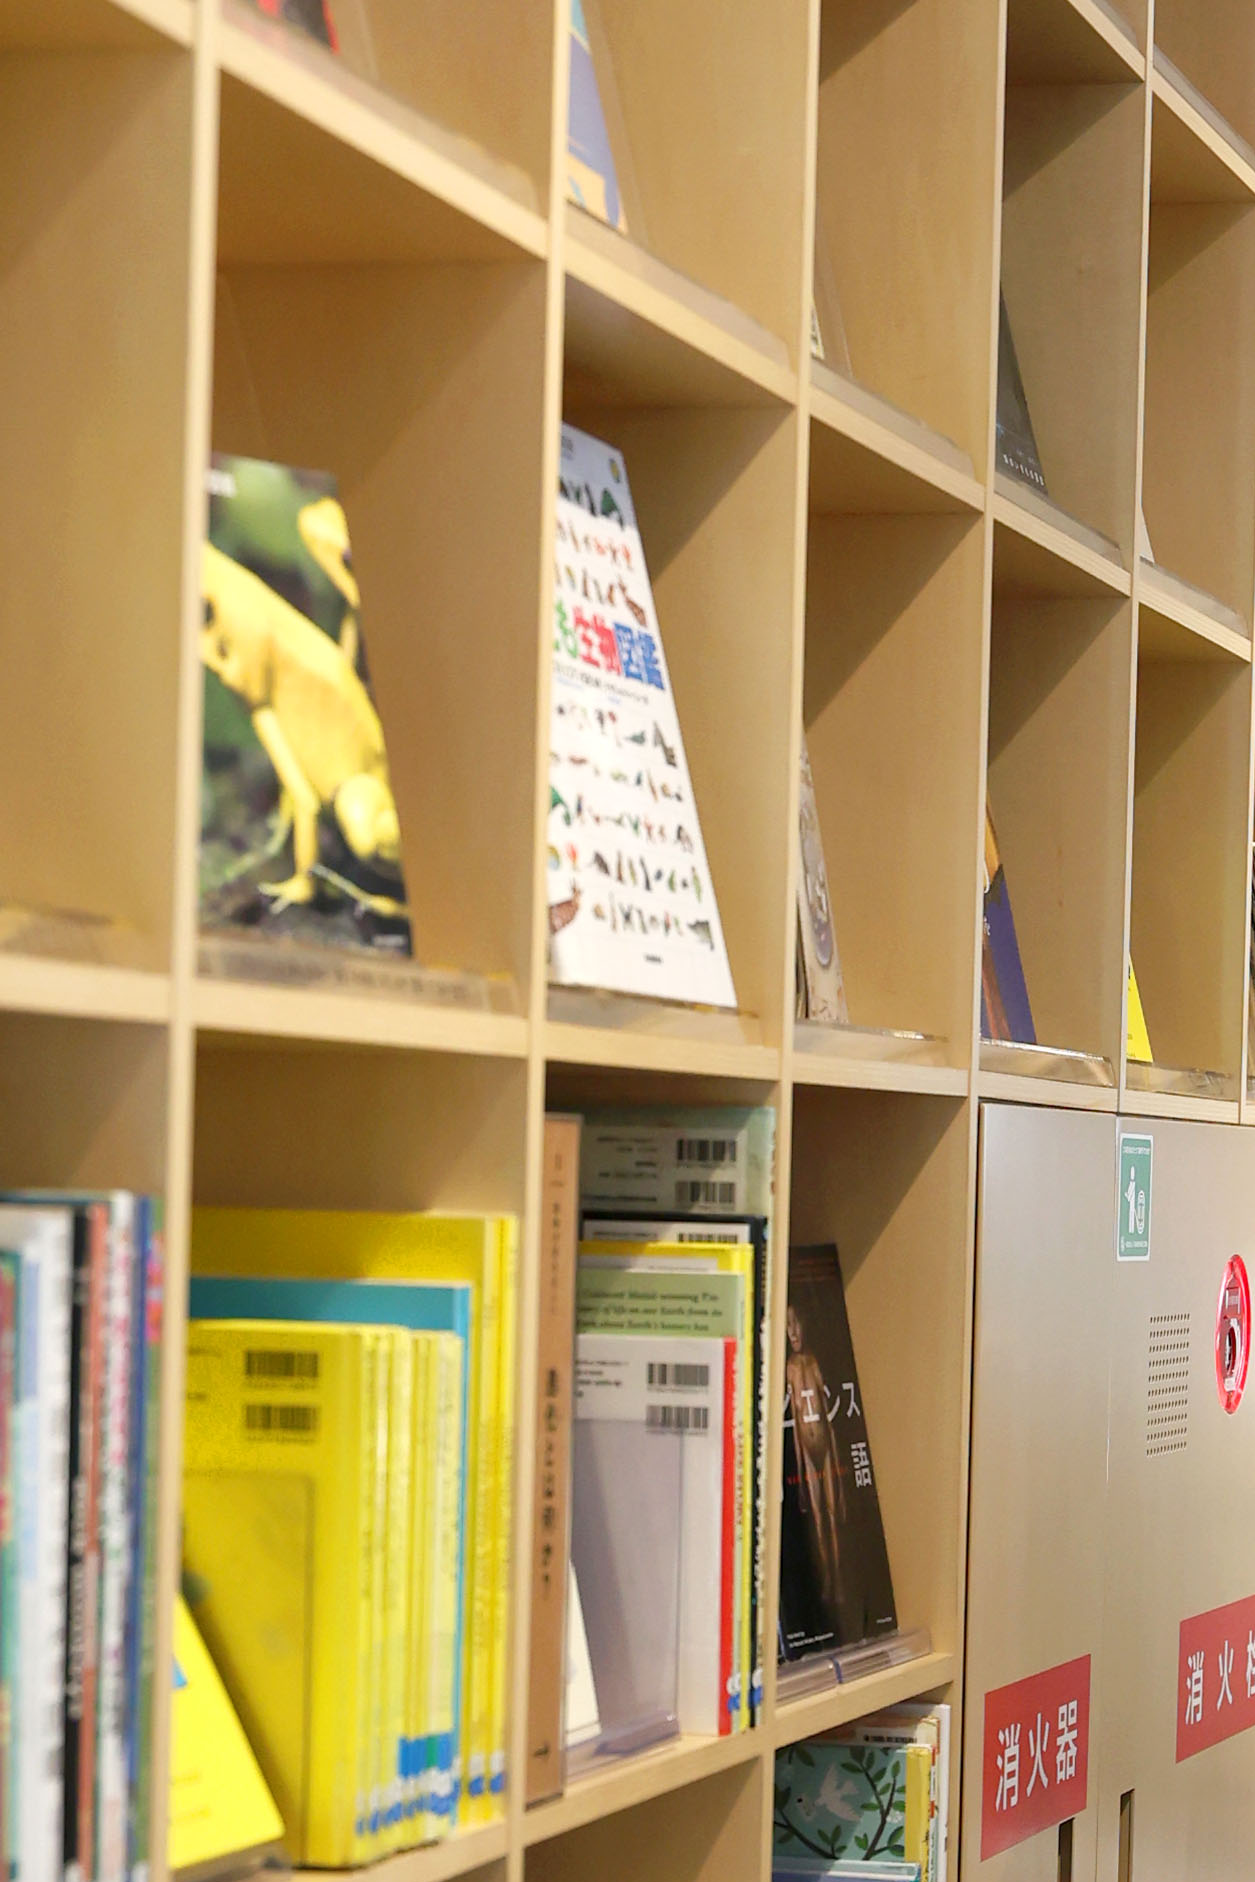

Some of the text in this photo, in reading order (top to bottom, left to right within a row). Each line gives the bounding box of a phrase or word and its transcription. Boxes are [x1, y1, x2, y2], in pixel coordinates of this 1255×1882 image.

[851, 1441, 872, 1488] 語
[994, 1699, 1078, 1811] 消火器
